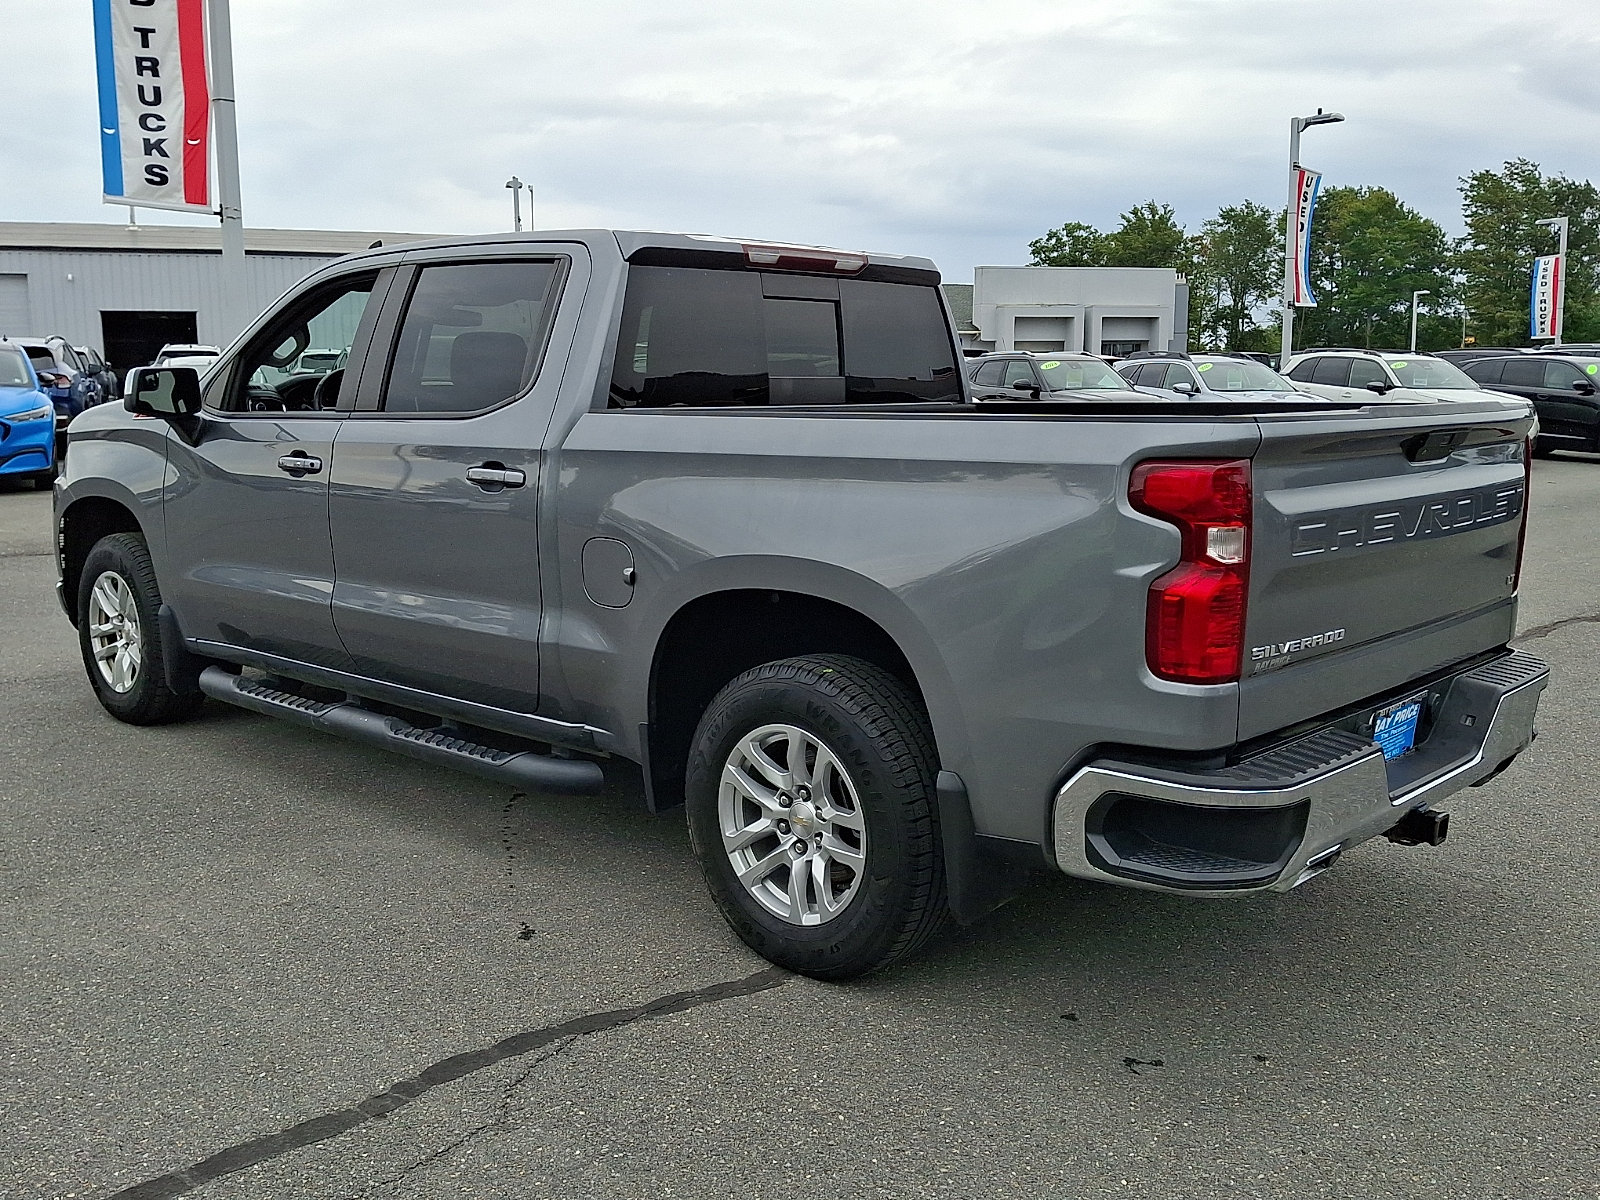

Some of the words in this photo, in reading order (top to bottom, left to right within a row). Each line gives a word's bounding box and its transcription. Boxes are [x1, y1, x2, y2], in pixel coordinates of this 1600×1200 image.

[133, 26, 170, 187] TRUCKS
[1540, 259, 1550, 288] USED
[1539, 291, 1548, 334] TRUCKS
[1291, 483, 1524, 557] CHEVROLET
[1251, 628, 1346, 661] SILVERADO
[1392, 703, 1418, 726] PRICE
